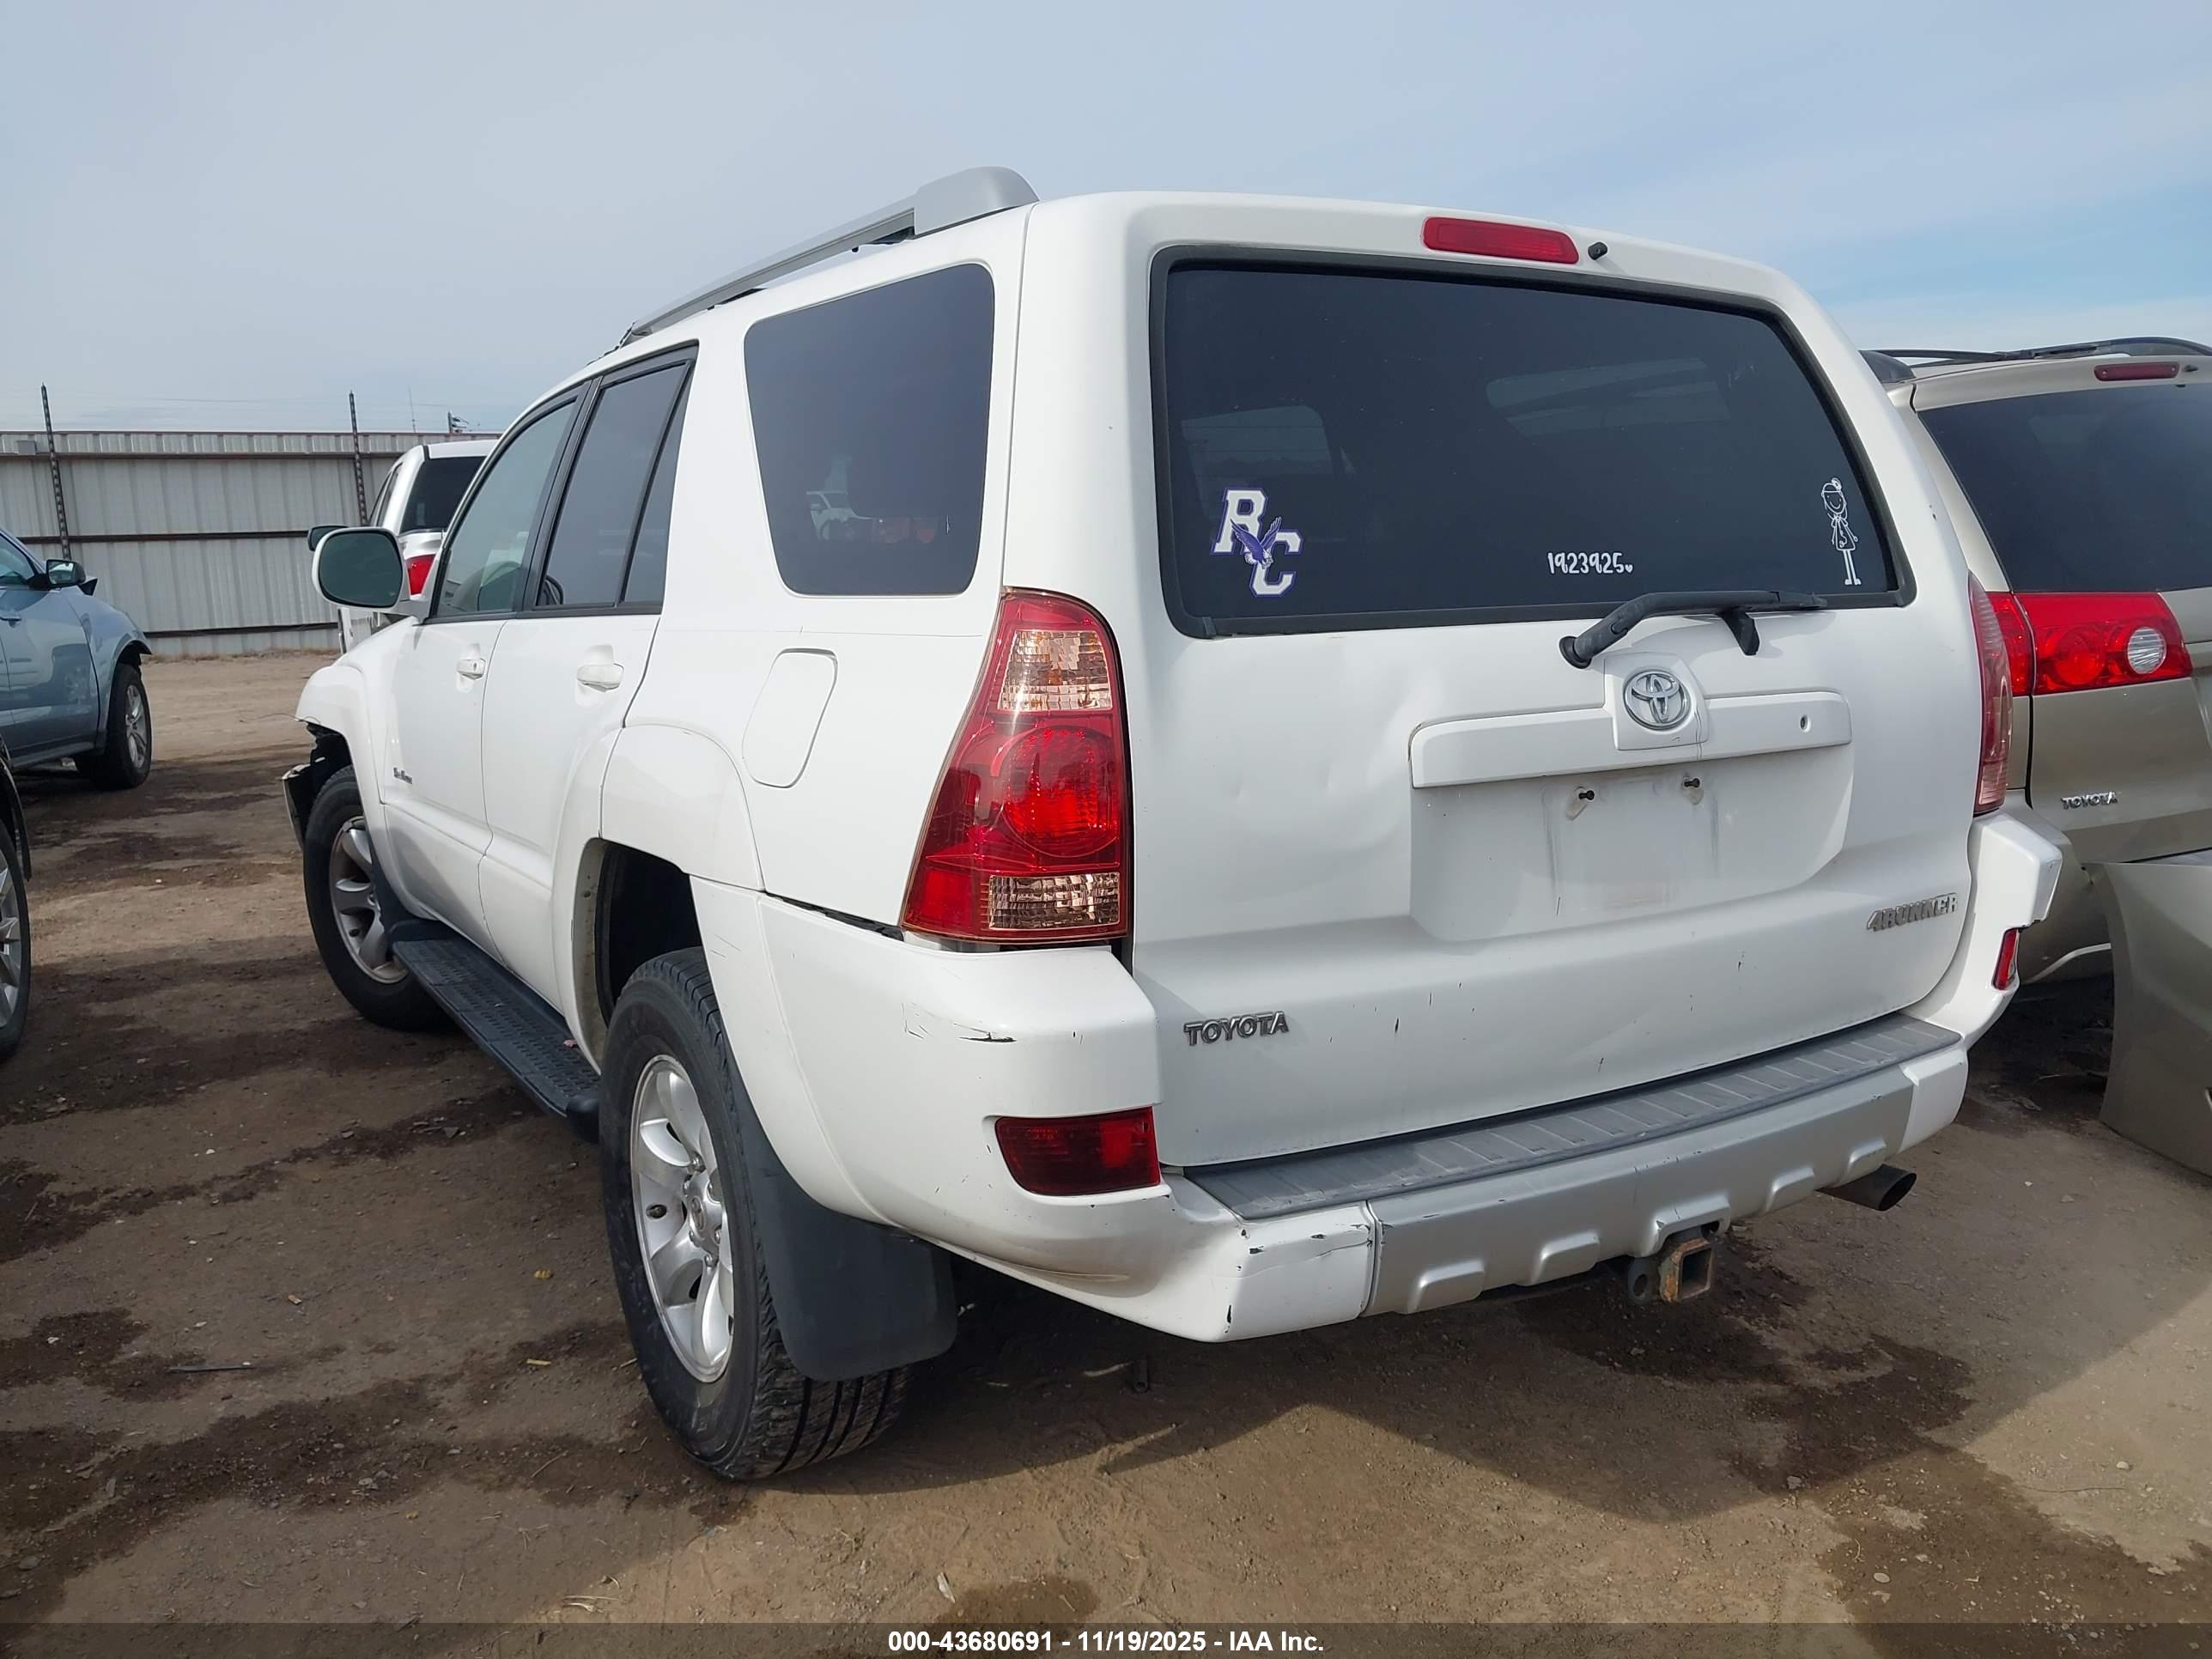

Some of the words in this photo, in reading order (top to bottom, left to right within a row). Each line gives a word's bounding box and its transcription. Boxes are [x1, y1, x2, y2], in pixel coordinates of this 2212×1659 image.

[1547, 552, 1625, 574] 1923925
[2061, 791, 2118, 810] TOYOTA
[1867, 892, 1958, 931] 4RUNNER
[1184, 1011, 1289, 1046] TOYOTA
